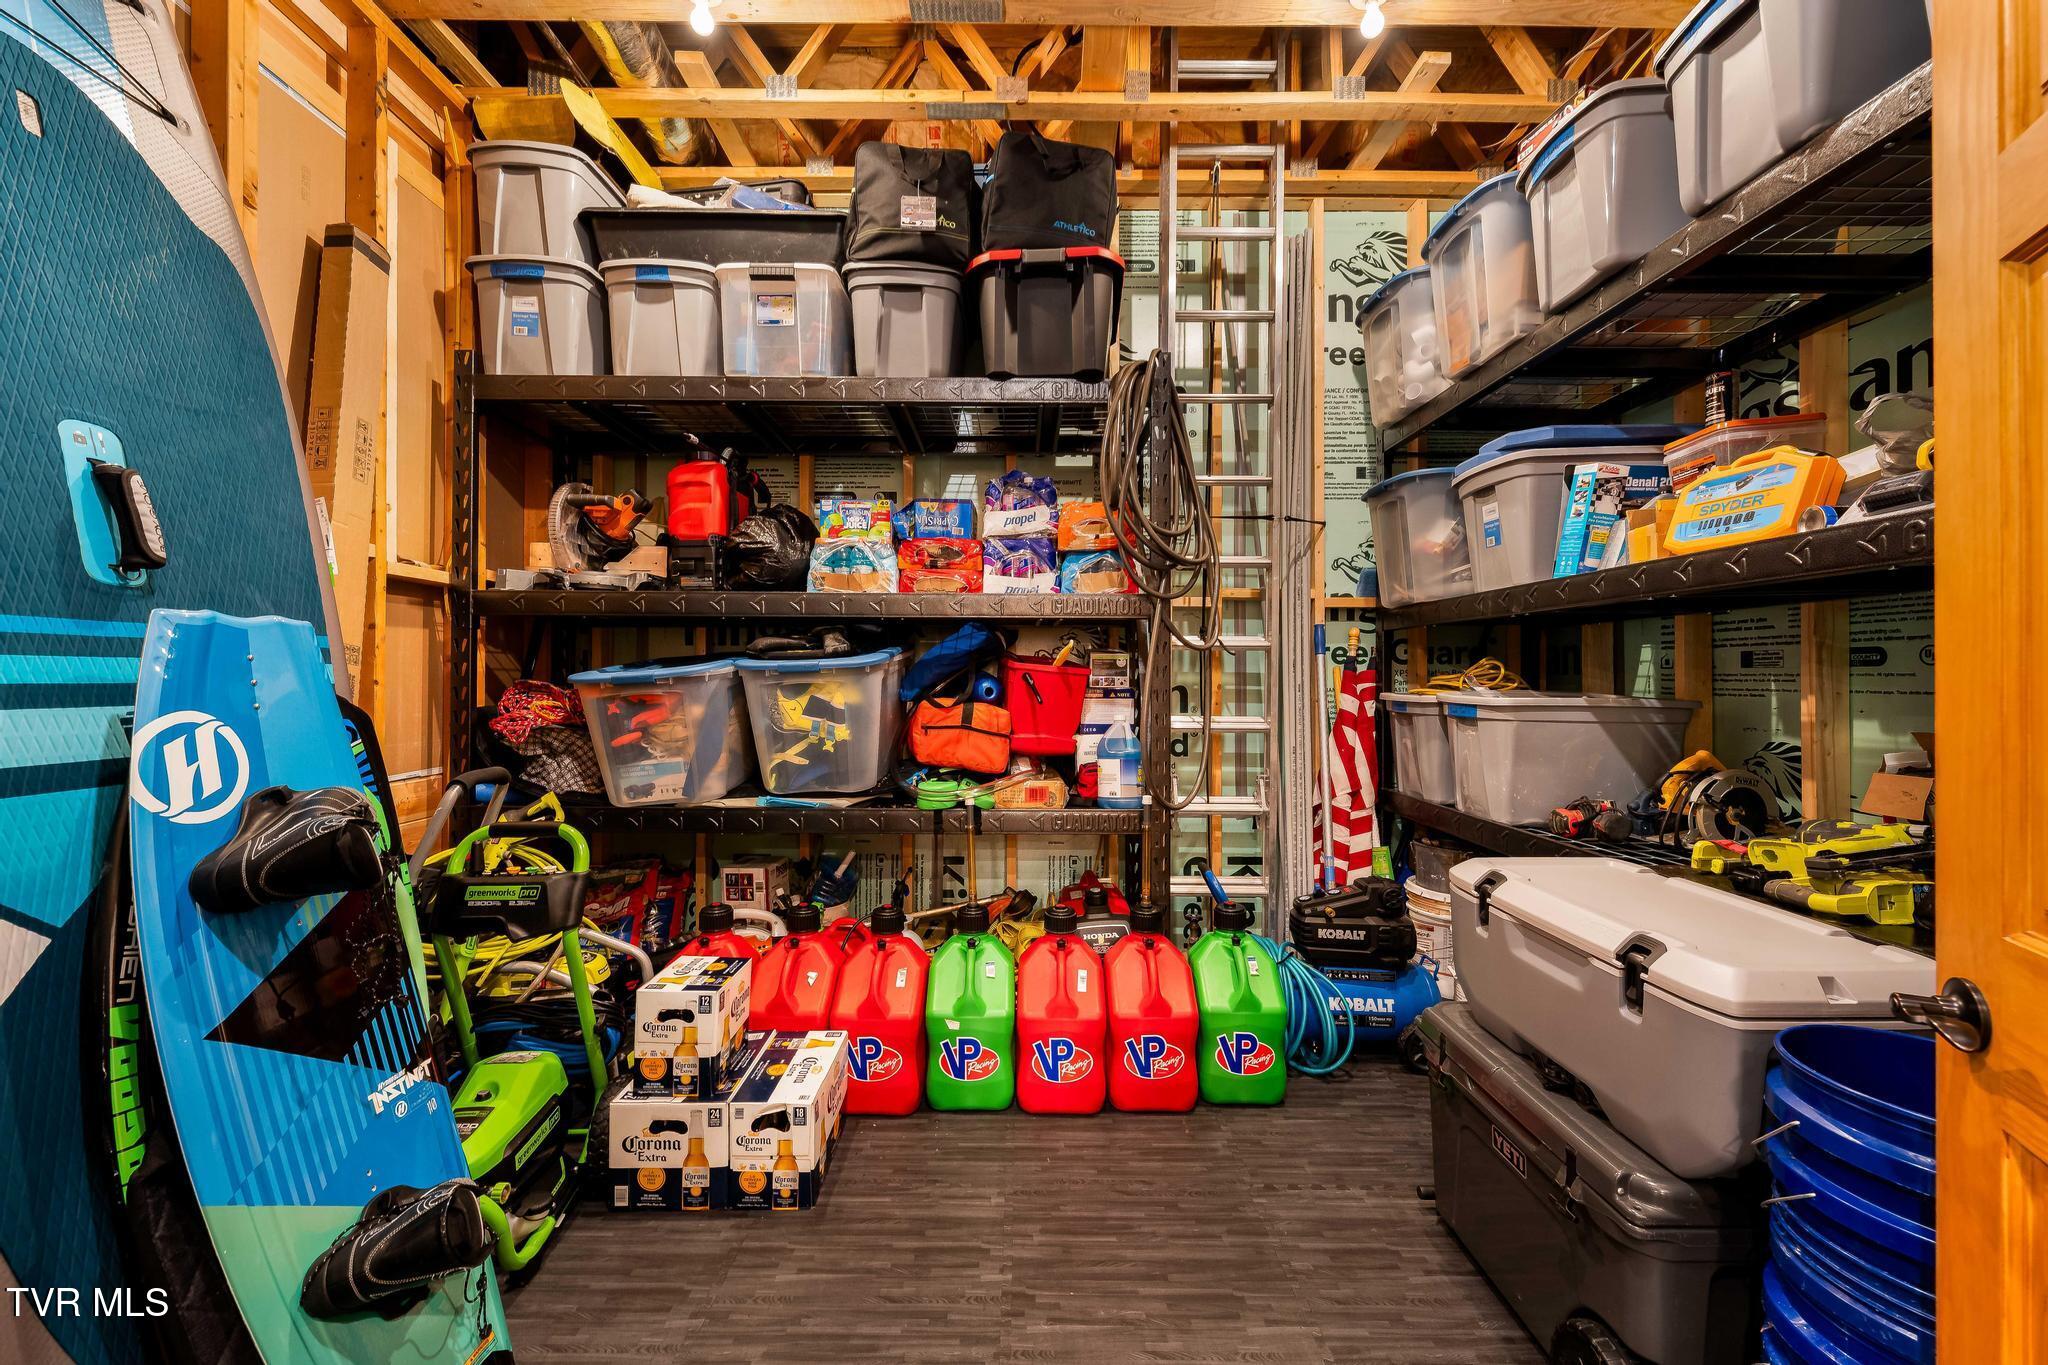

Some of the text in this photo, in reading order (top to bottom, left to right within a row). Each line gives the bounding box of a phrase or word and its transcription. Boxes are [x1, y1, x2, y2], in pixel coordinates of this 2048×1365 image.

[1625, 476, 1659, 487] Denali
[1698, 494, 1765, 517] SPYDER
[843, 520, 868, 529] JUICE
[1003, 512, 1037, 528] propel
[1051, 598, 1143, 615] GLADIATOR
[1051, 812, 1143, 833] GLADIATOR
[468, 888, 537, 898] greenworks pro
[1082, 932, 1120, 940] HONDA
[1317, 928, 1366, 941] KOBALT
[701, 996, 710, 1006] 12
[1328, 996, 1395, 1013] KOBALT
[642, 1021, 678, 1034] Corona
[651, 1031, 668, 1039] Extra
[939, 1037, 1000, 1081] VP Racing
[1032, 1038, 1093, 1081] VP Racing
[1124, 1035, 1185, 1080] VP Racing
[1216, 1032, 1276, 1077] VP Racing
[674, 1061, 698, 1070] Corona
[868, 1056, 901, 1076] Racing
[710, 1109, 720, 1119] 24
[795, 1108, 804, 1118] 18
[516, 1124, 548, 1166] greenworks
[621, 1135, 681, 1156] Corona
[735, 1134, 772, 1147] Corona
[744, 1144, 763, 1152] Extra
[1494, 1129, 1526, 1172] YETI
[637, 1151, 667, 1162] Extra
[684, 1172, 708, 1181] Corona
[774, 1175, 798, 1184] Corona
